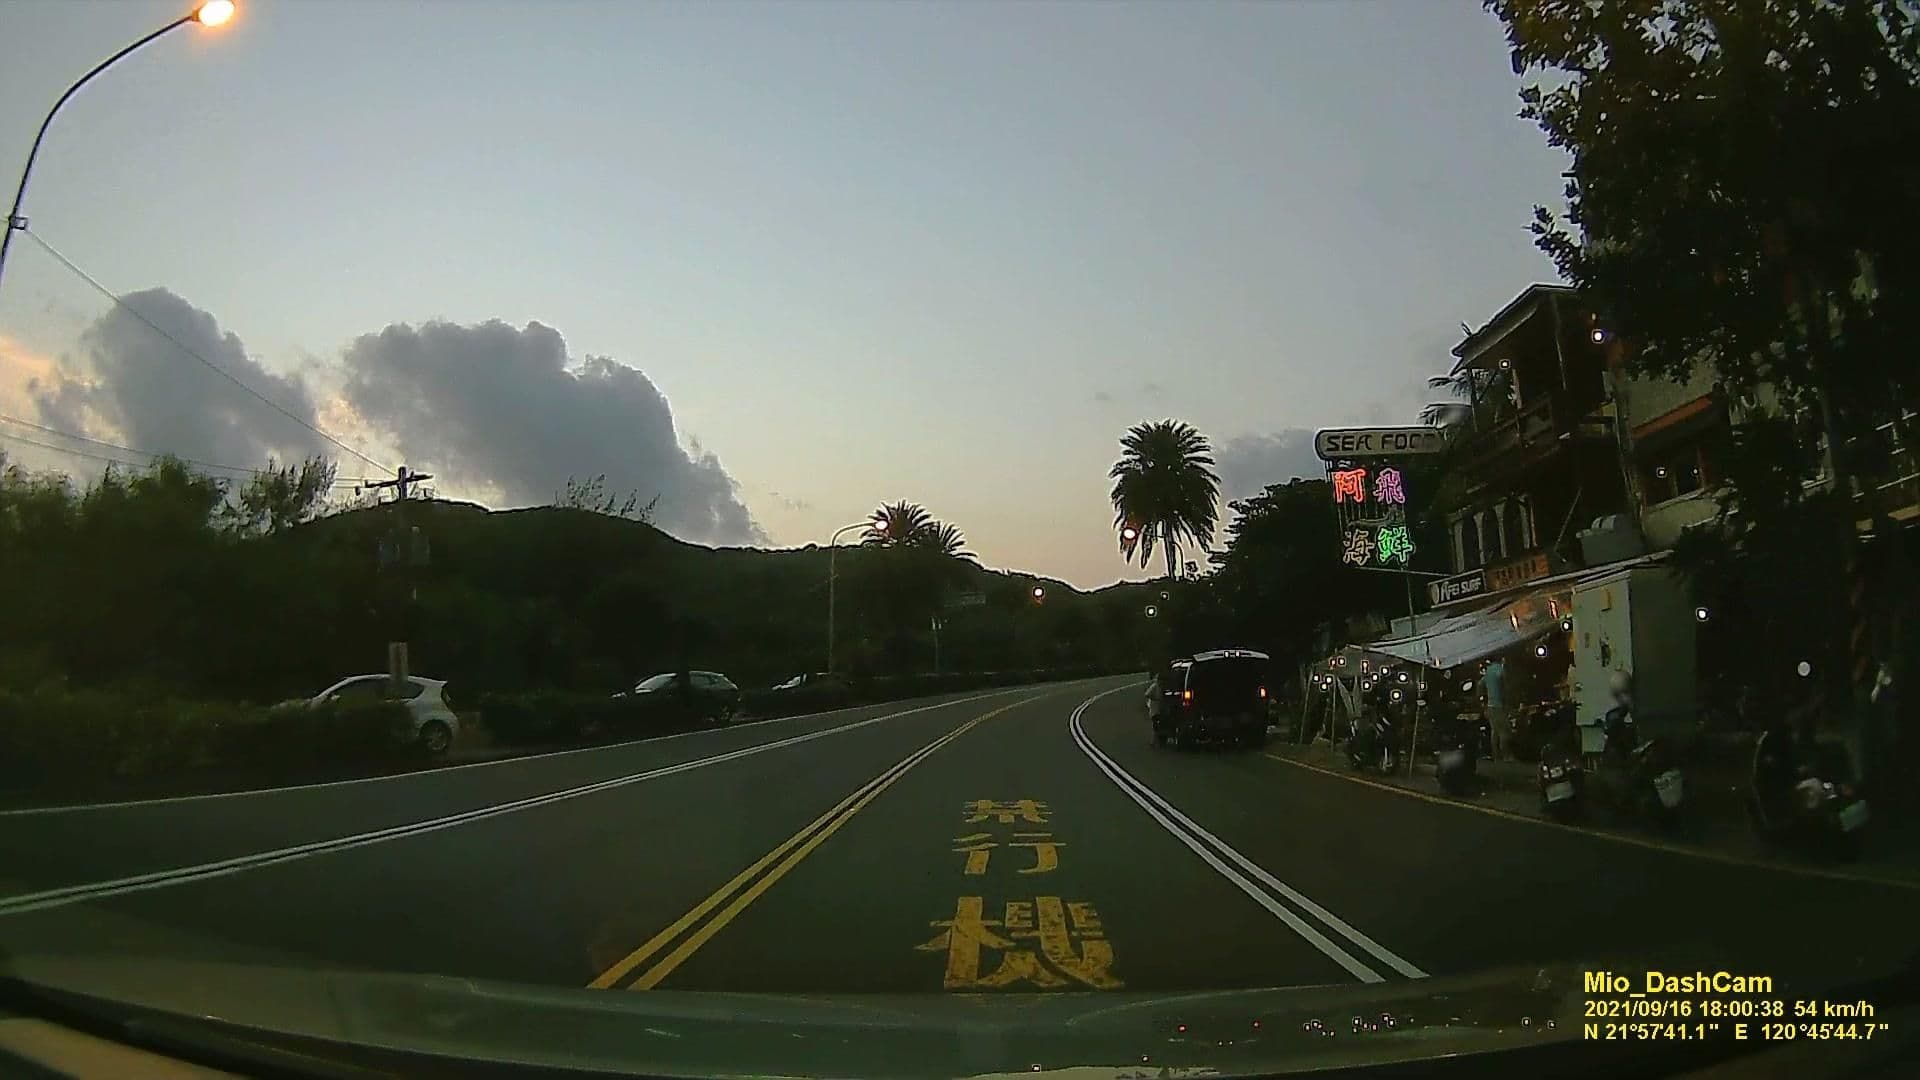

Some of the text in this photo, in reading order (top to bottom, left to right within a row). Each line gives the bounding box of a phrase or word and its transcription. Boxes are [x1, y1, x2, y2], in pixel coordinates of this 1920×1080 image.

[1326, 433, 1372, 451] SEA
[1332, 467, 1406, 504] 阿飛
[1342, 526, 1415, 566] 海鮮
